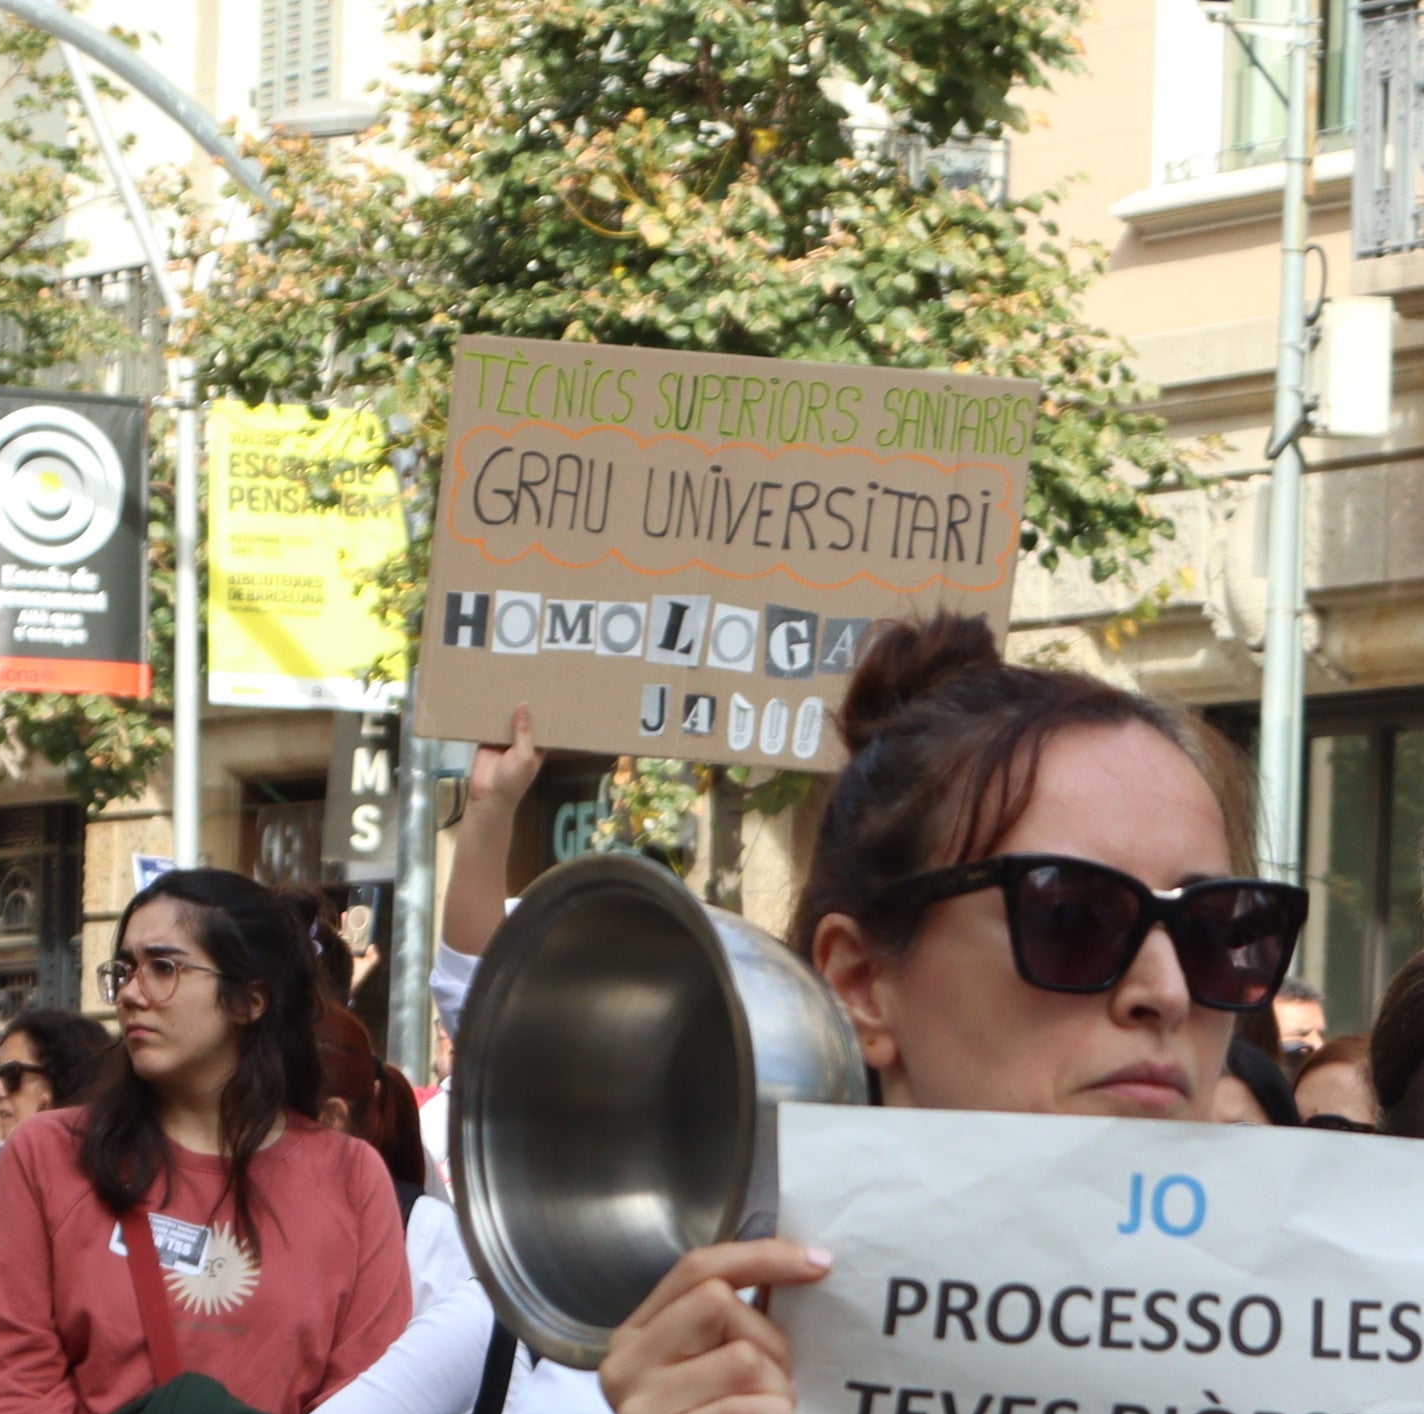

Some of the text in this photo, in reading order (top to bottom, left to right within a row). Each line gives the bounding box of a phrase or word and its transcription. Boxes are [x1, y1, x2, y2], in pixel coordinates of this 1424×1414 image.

[474, 446, 613, 534] GRAU
[443, 591, 856, 671] HOMOLOGA
[1117, 1172, 1208, 1238] JO
[883, 1276, 1424, 1364] PROCESSO LES
